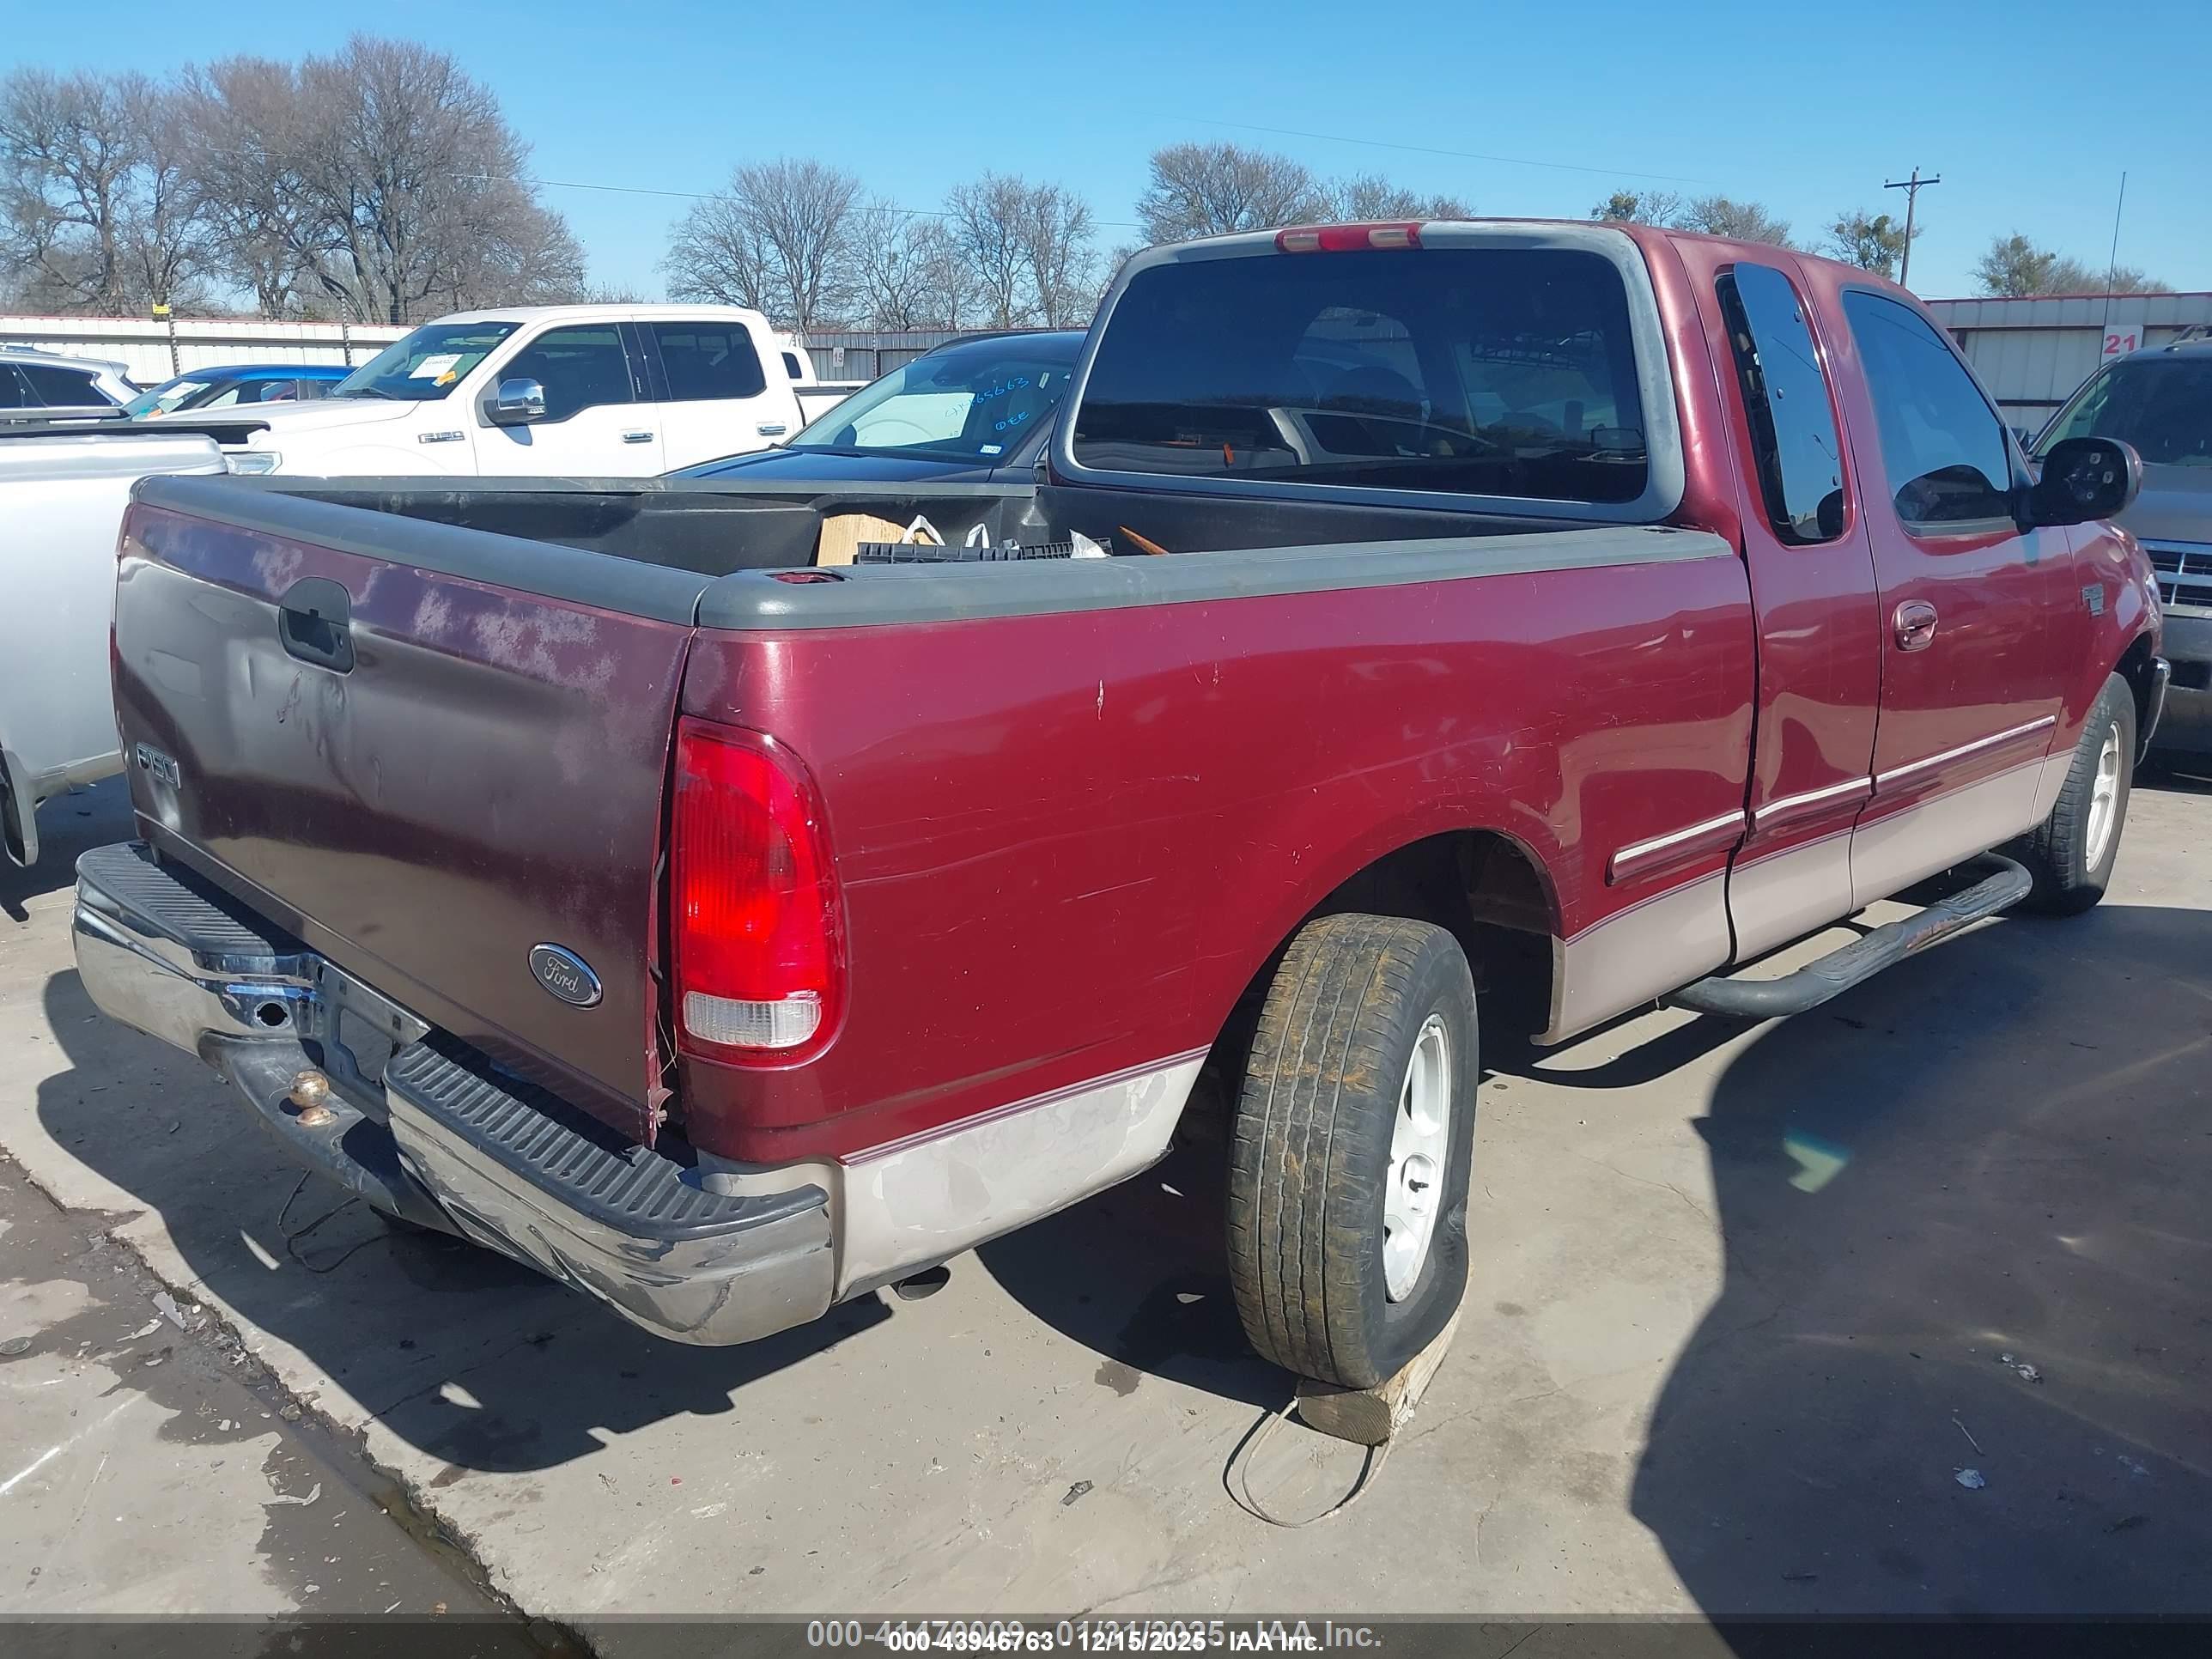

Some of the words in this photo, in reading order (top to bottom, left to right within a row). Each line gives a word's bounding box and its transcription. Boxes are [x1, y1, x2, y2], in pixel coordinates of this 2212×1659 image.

[2104, 334, 2136, 354] 21
[834, 352, 843, 362] 15
[544, 956, 580, 994] Ford
